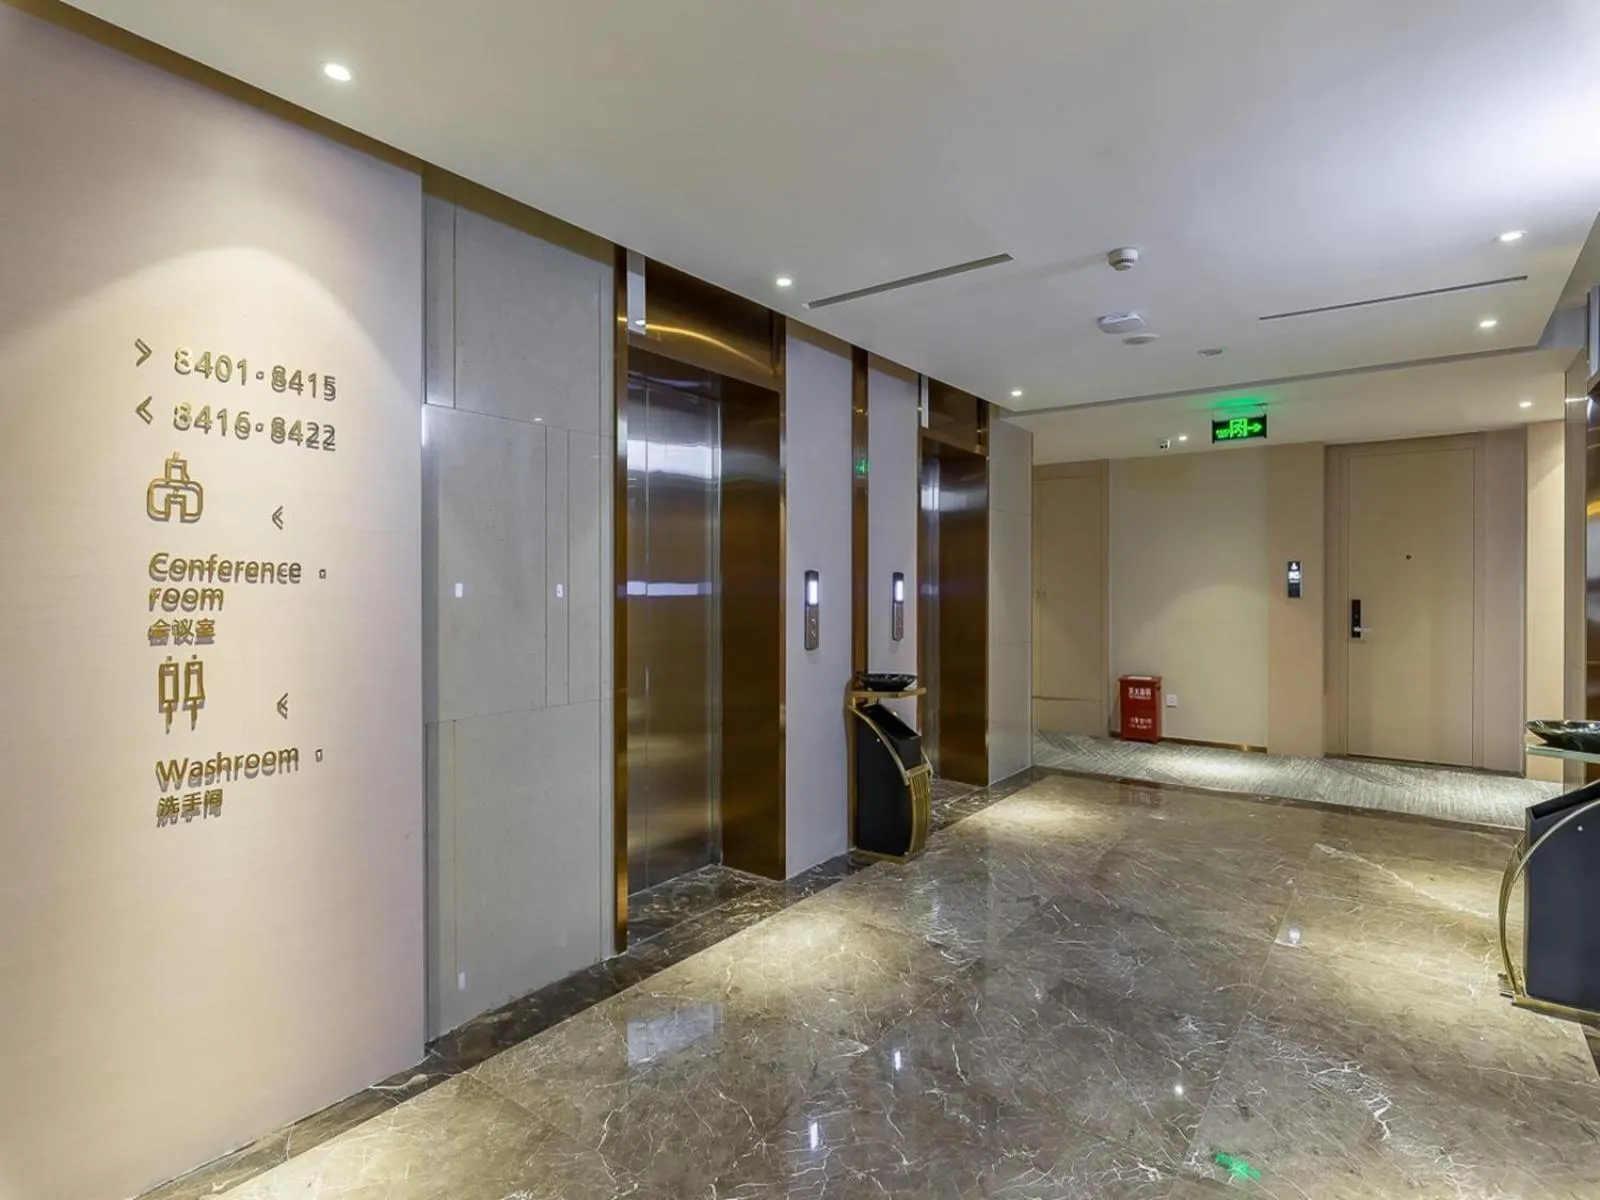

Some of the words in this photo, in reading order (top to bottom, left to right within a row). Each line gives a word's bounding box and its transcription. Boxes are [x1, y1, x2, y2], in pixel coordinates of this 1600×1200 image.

[149, 552, 302, 584] Conference
[149, 587, 224, 612] room
[148, 618, 215, 645] 会议室
[155, 747, 299, 791] Washroom
[156, 788, 223, 826] 洗手间
